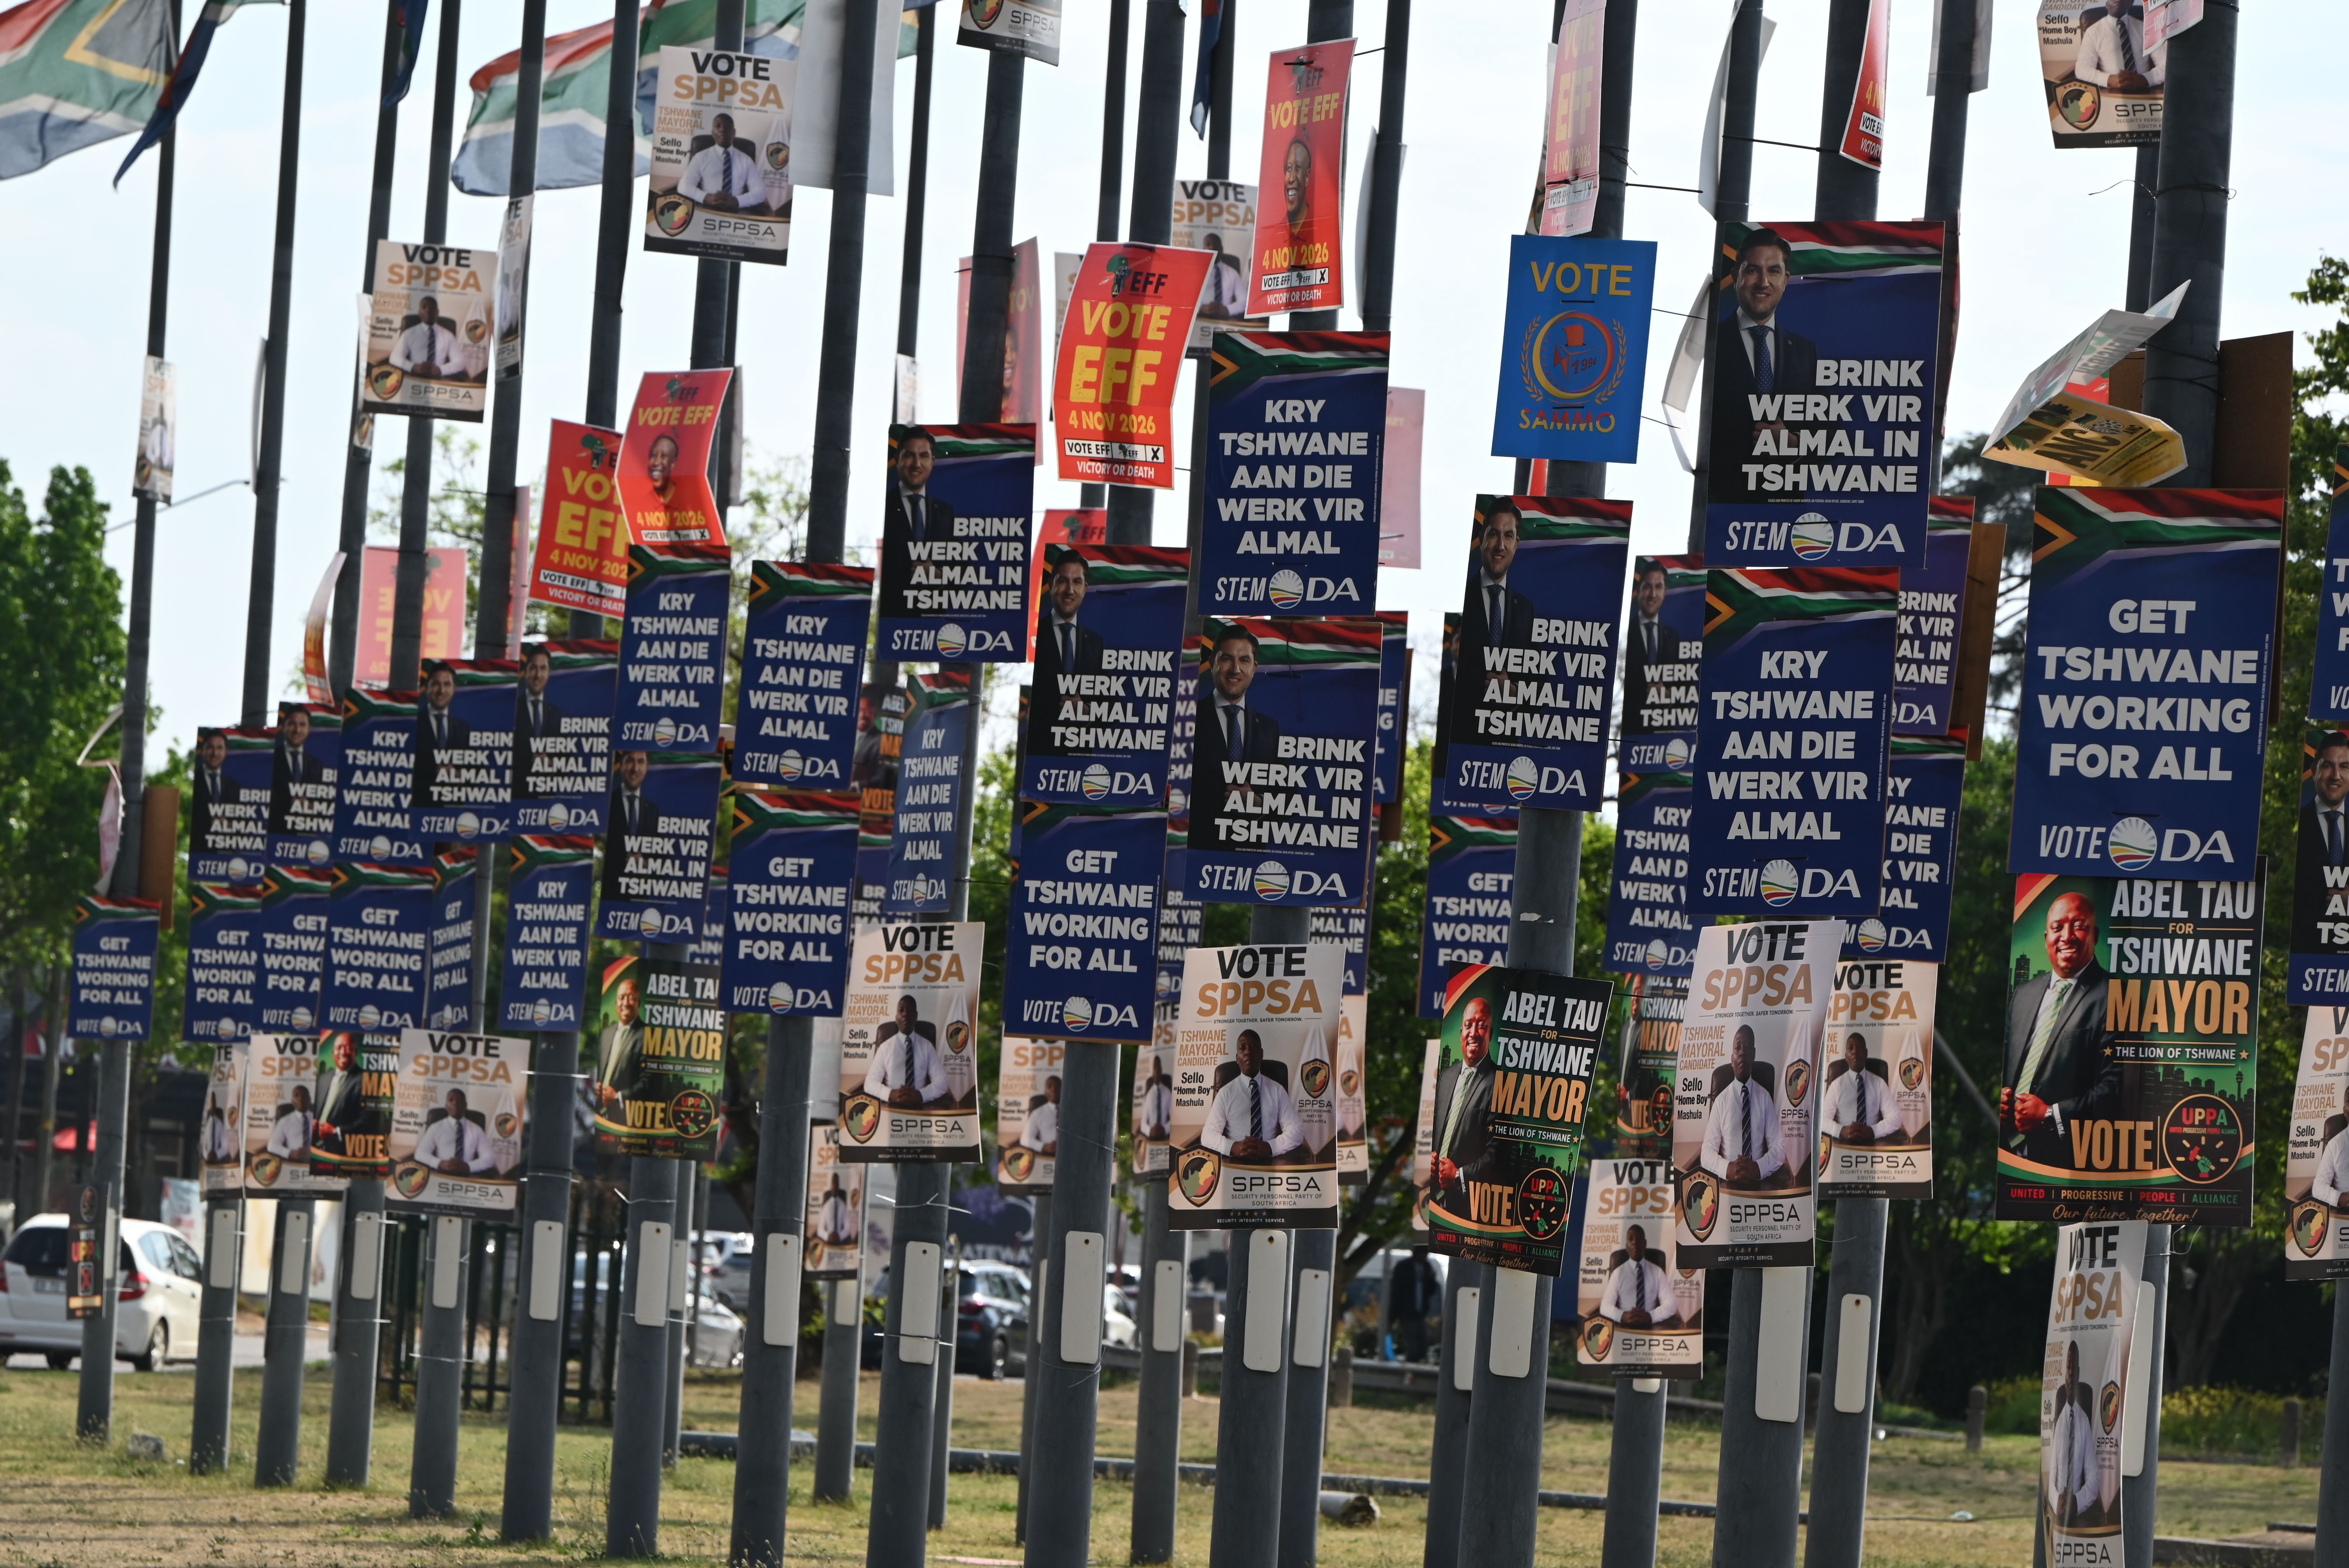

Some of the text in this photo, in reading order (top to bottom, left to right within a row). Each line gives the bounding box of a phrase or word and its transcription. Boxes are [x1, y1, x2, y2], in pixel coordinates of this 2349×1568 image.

[2045, 15, 2069, 24] Sello
[692, 52, 770, 80] VOTE
[674, 75, 784, 109] SPPSA
[659, 107, 703, 118] TSHWANE
[1271, 93, 1339, 129] VOTE EFF
[658, 117, 704, 130] MAYORAL
[660, 136, 681, 147] Sello
[1262, 242, 1329, 269] 4 NOV 2026
[1130, 271, 1168, 294] EFF
[1530, 262, 1633, 296] VOTE
[1267, 290, 1321, 305] VICTORY OR DEATH
[1082, 301, 1171, 340] VOTE
[1069, 345, 1162, 406] EFF
[1572, 357, 1597, 374] 1994
[1816, 360, 1925, 387] BRINK
[638, 405, 714, 426] VOTE EFF
[1265, 399, 1326, 422] KRY
[1748, 395, 1921, 422] WERK VIR
[1069, 410, 1156, 435] 4 NOV 2026
[1518, 408, 1615, 433] SAMMO
[1067, 442, 1138, 458] VOTE EFF EFF
[1219, 432, 1368, 455] TSHWANE
[1752, 429, 1919, 457] ALMAL IN
[2034, 429, 2121, 468] ANC
[1076, 461, 1155, 479] VICTORY OR DEATH
[1742, 464, 1918, 492] TSHWANE
[953, 517, 1025, 537] BRINK
[1726, 522, 1905, 552] STEM DA
[908, 542, 1024, 561] WERK VIR
[1236, 531, 1340, 554] ALMAL
[910, 566, 1022, 585] ALMAL IN
[903, 590, 1022, 609] TSHWANE
[1215, 577, 1360, 601] STEM DA
[2109, 599, 2196, 634] GET
[892, 629, 1014, 652] STEM DA
[1760, 650, 1828, 679] KRY
[2037, 646, 2259, 684] TSHWANE
[1711, 691, 1874, 719] TSHWANE
[2038, 694, 2250, 733] WORKING
[560, 717, 610, 733] BRINK
[2049, 743, 2233, 781] FOR ALL
[526, 777, 606, 792] TSHWANE
[517, 808, 600, 826] STEM DA
[2040, 825, 2234, 862] VOTE DA
[1066, 849, 1117, 874] GET
[538, 881, 567, 898] KRY
[1024, 880, 1154, 908] TSHWANE
[1703, 868, 1861, 898] STEM DA
[2110, 879, 2255, 919] ABEL TAU
[515, 904, 585, 921] TSHWANE
[519, 927, 577, 944] AAN DIE
[1024, 912, 1148, 941] WORKING
[2168, 923, 2194, 934] FOR
[100, 937, 130, 951] GET
[1727, 924, 1809, 965] VOTE
[77, 954, 151, 969] TSHWANE
[512, 948, 581, 966] WERK VIR
[1029, 945, 1137, 973] FOR ALL
[1217, 947, 1307, 979] VOTE
[2107, 937, 2252, 976] TSHWANE
[77, 971, 149, 987] WORKING
[520, 971, 569, 989] ALMAL
[1701, 964, 1813, 1010] SPPSA
[80, 989, 143, 1005] FOR ALL
[1197, 979, 1322, 1017] SPPSA
[2105, 979, 2249, 1035] MAYOR
[507, 1003, 575, 1021] STEM DA
[1023, 1000, 1139, 1027] VOTE DA
[1502, 991, 1603, 1032] ABEL TAU
[77, 1019, 143, 1035] VOTE DA
[1180, 1029, 1226, 1042] TSHWANE
[1177, 1057, 1218, 1066] CANDIDATE
[1179, 1043, 1229, 1057] MAYORAL
[1497, 1037, 1594, 1077] TSHWANE
[2116, 1047, 2236, 1060] THE LION OF TSHWANE
[1181, 1072, 1204, 1084] Sello
[1682, 1077, 1703, 1092] Sello
[1176, 1098, 1204, 1108] Mashula
[1491, 1071, 1586, 1124] MAYOR
[1677, 1109, 1702, 1120] Mashula
[2181, 1108, 2228, 1126] UPPA
[2070, 1119, 2153, 1171] VOTE
[1233, 1177, 1321, 1192] SPPSA
[2011, 1188, 2045, 1199] UNITED
[2061, 1190, 2124, 1201] PROGRESSIVE
[2139, 1192, 2175, 1203] PEOPLE
[2192, 1193, 2238, 1204] ALLIANCE
[2053, 1205, 2080, 1219] Our
[2136, 1208, 2198, 1223] together!
